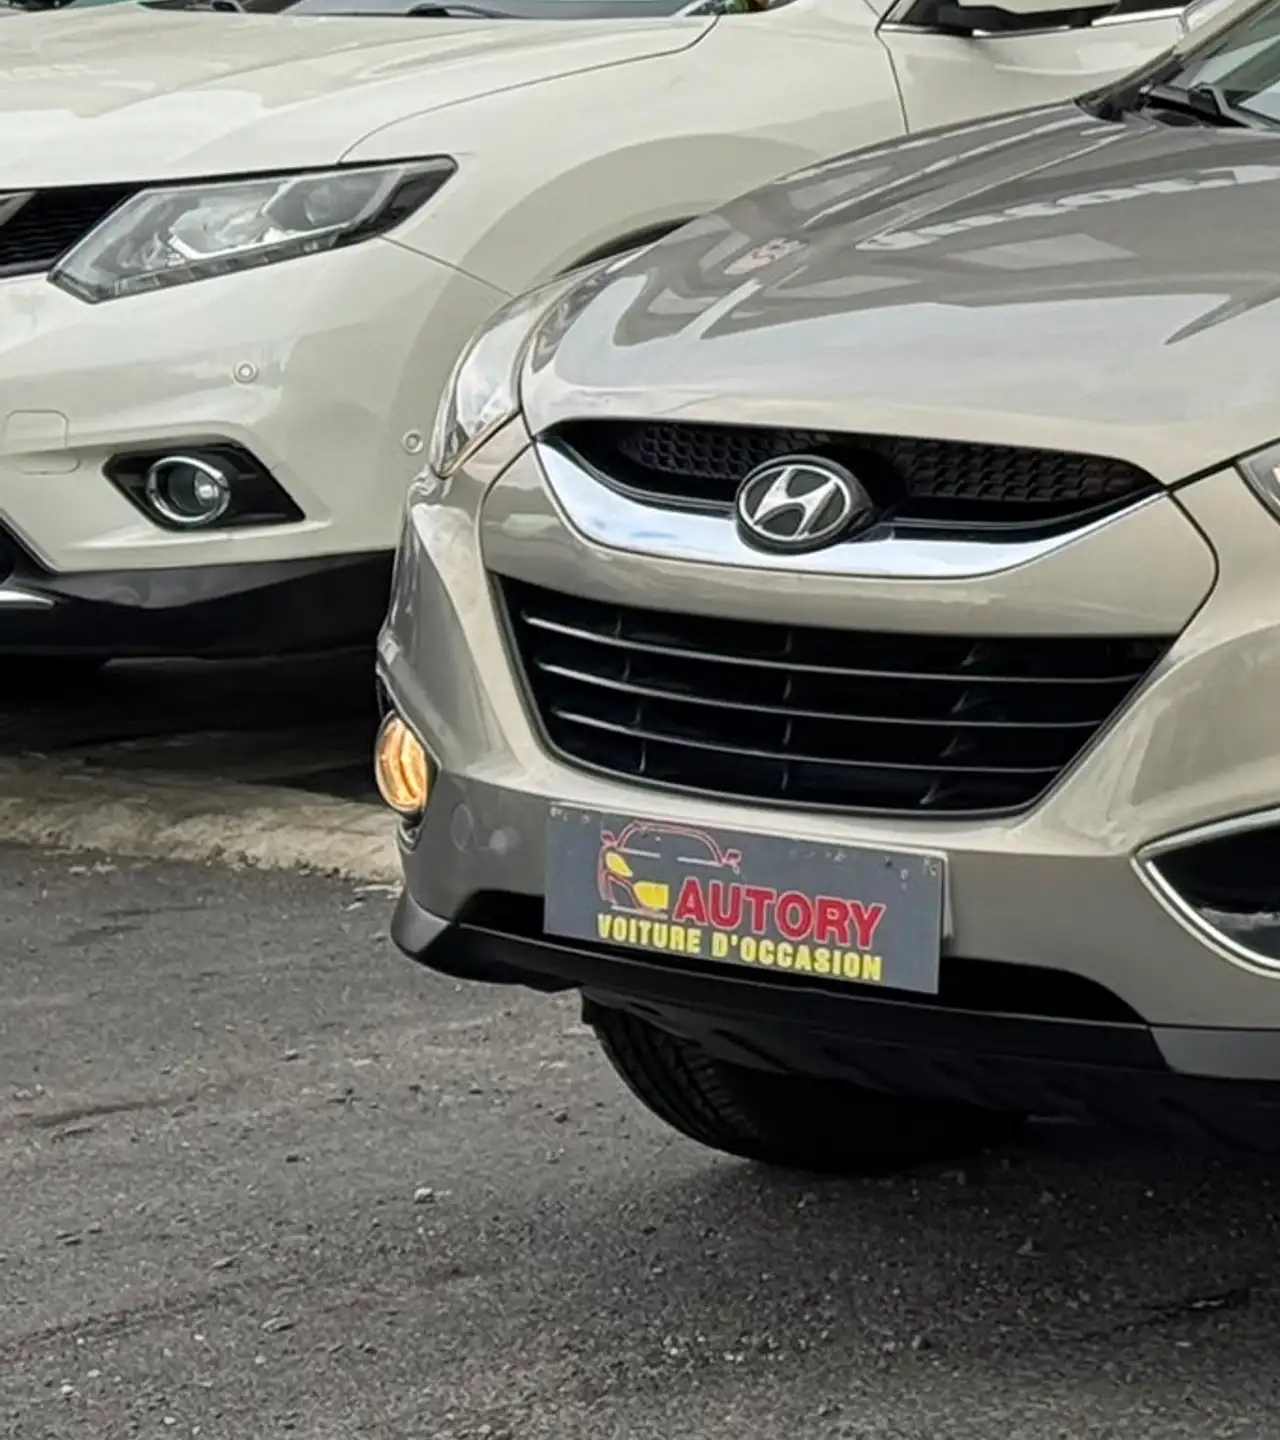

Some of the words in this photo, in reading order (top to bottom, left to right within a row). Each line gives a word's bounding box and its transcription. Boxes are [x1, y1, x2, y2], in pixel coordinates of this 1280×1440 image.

[597, 913, 701, 955] VOITURE
[711, 931, 882, 982] D'OCCASION
[673, 875, 886, 951] AUTORY
